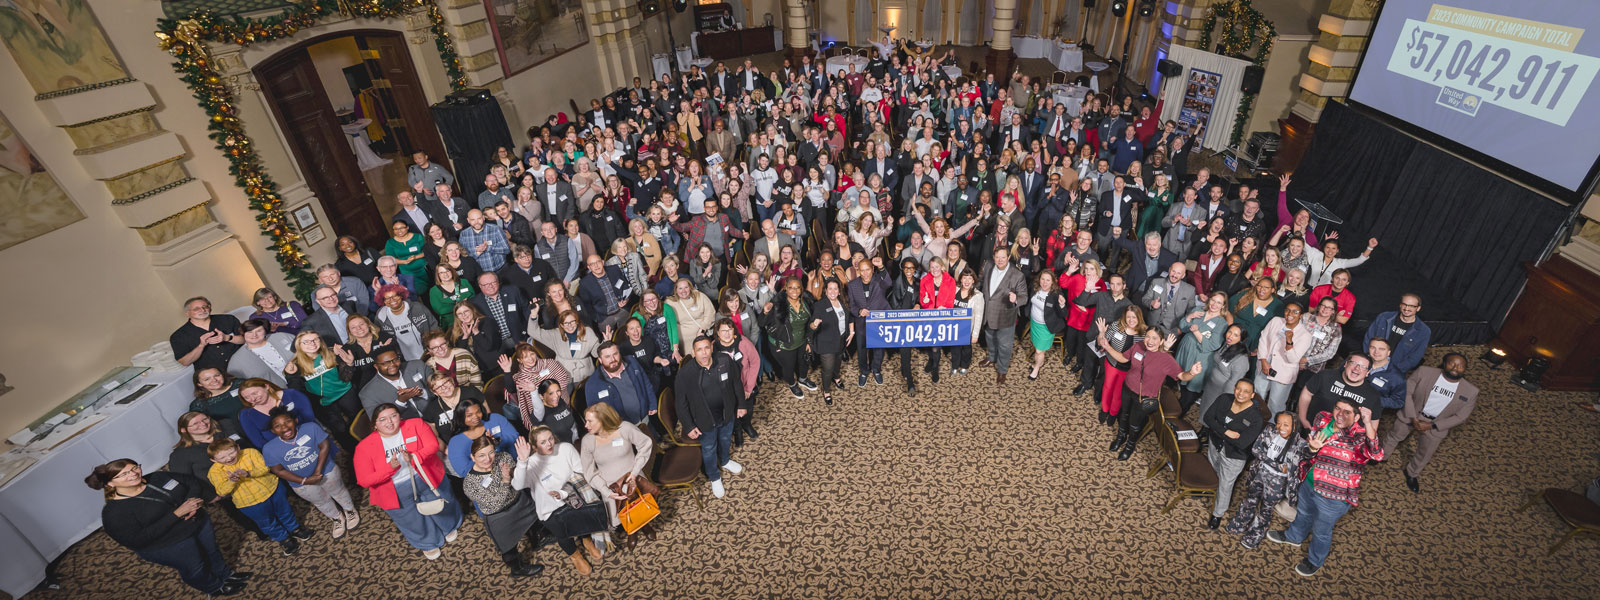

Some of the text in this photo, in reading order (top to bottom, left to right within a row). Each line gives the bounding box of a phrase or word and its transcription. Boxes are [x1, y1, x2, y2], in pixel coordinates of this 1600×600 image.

[1432, 9, 1574, 47] 2023 COMMUNITY CAMPAIGN TOTAL
[1406, 25, 1580, 111] $57,042,911
[1443, 87, 1465, 100] United
[1448, 96, 1461, 107] Way
[878, 323, 959, 345] $57,042,911
[354, 358, 366, 367] LIVE
[1330, 385, 1364, 404] LIVE UNITED
[1431, 384, 1455, 399] VE UNIT
